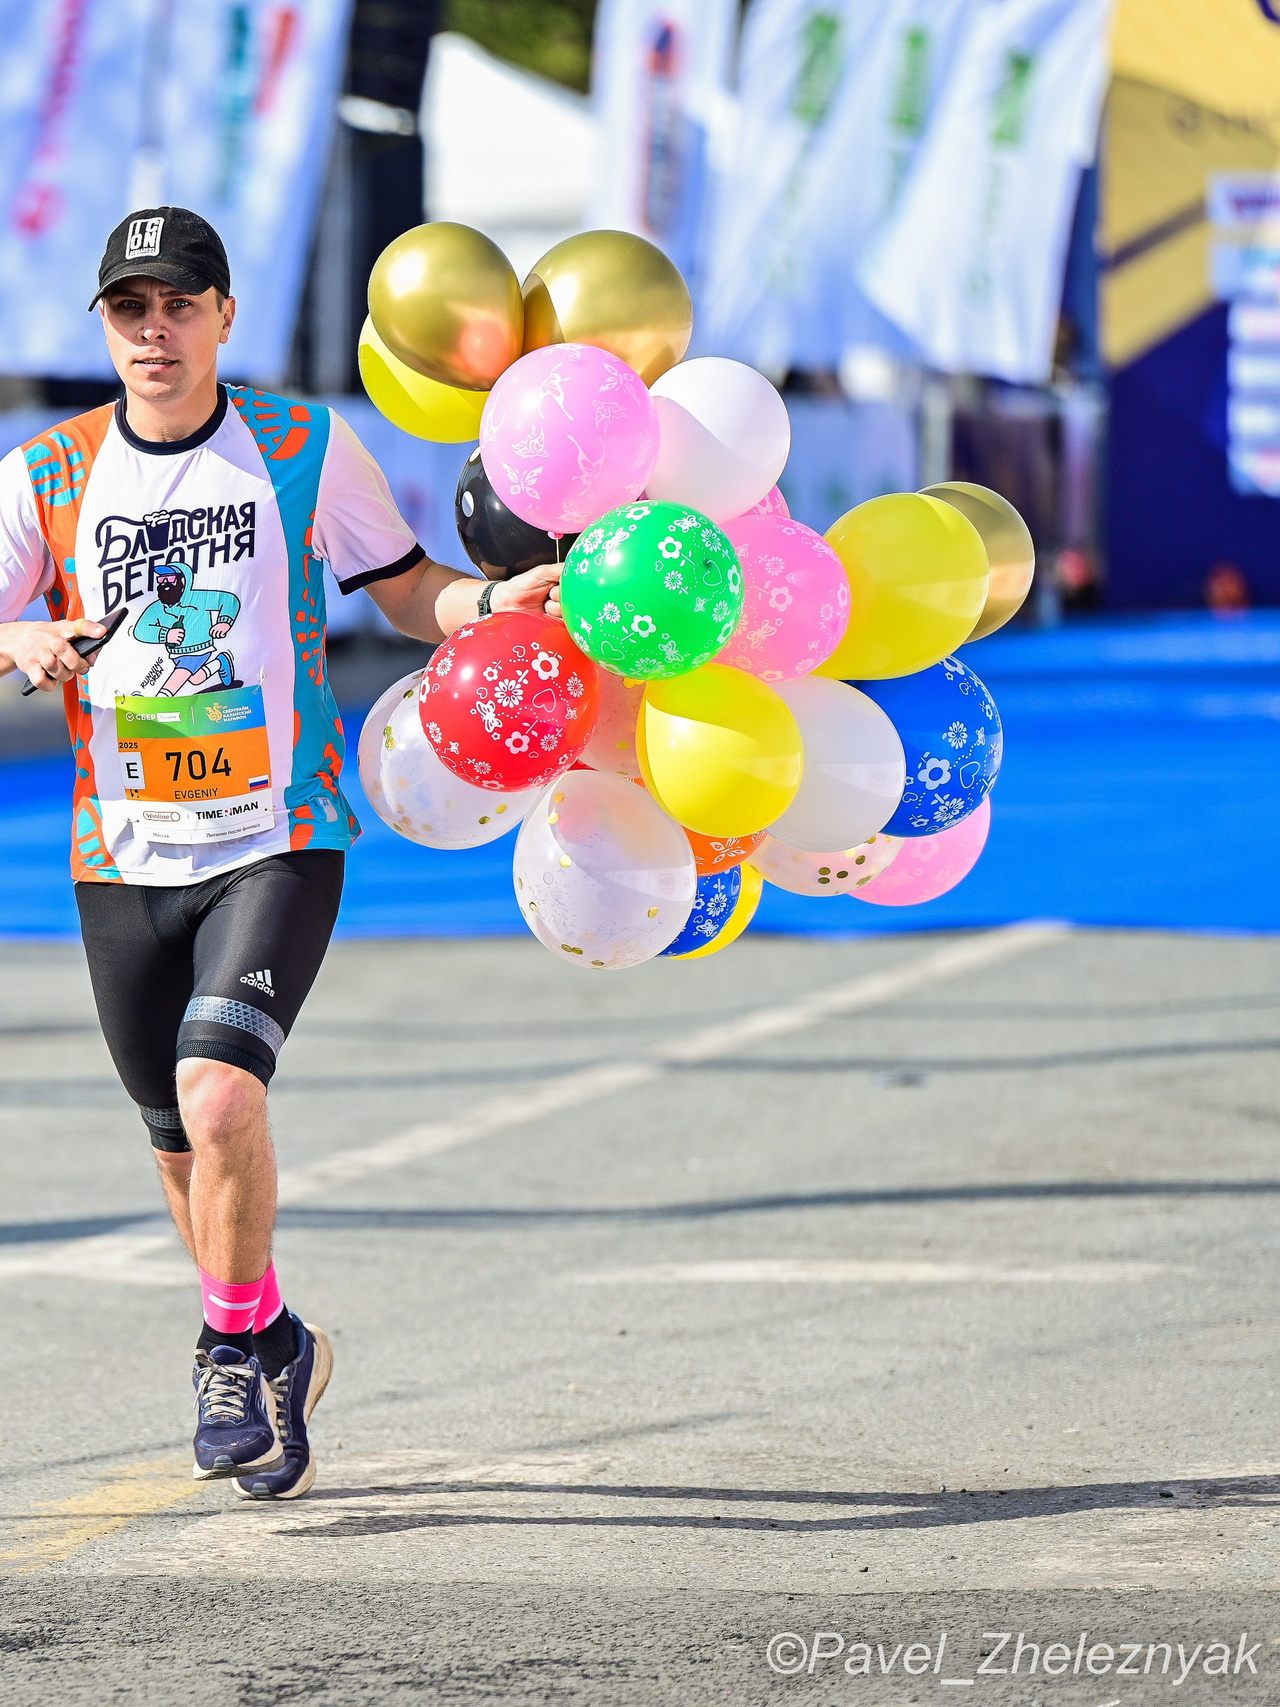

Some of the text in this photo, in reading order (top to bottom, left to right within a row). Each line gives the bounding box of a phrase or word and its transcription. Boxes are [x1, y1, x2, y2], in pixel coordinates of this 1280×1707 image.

[95, 501, 256, 569] БЛДСКАЯ
[140, 656, 164, 689] RUNNING
[149, 666, 164, 686] CREW
[125, 762, 140, 779] E
[165, 747, 232, 782] 704
[174, 787, 218, 800] EVGENIY
[239, 976, 276, 998] adidas
